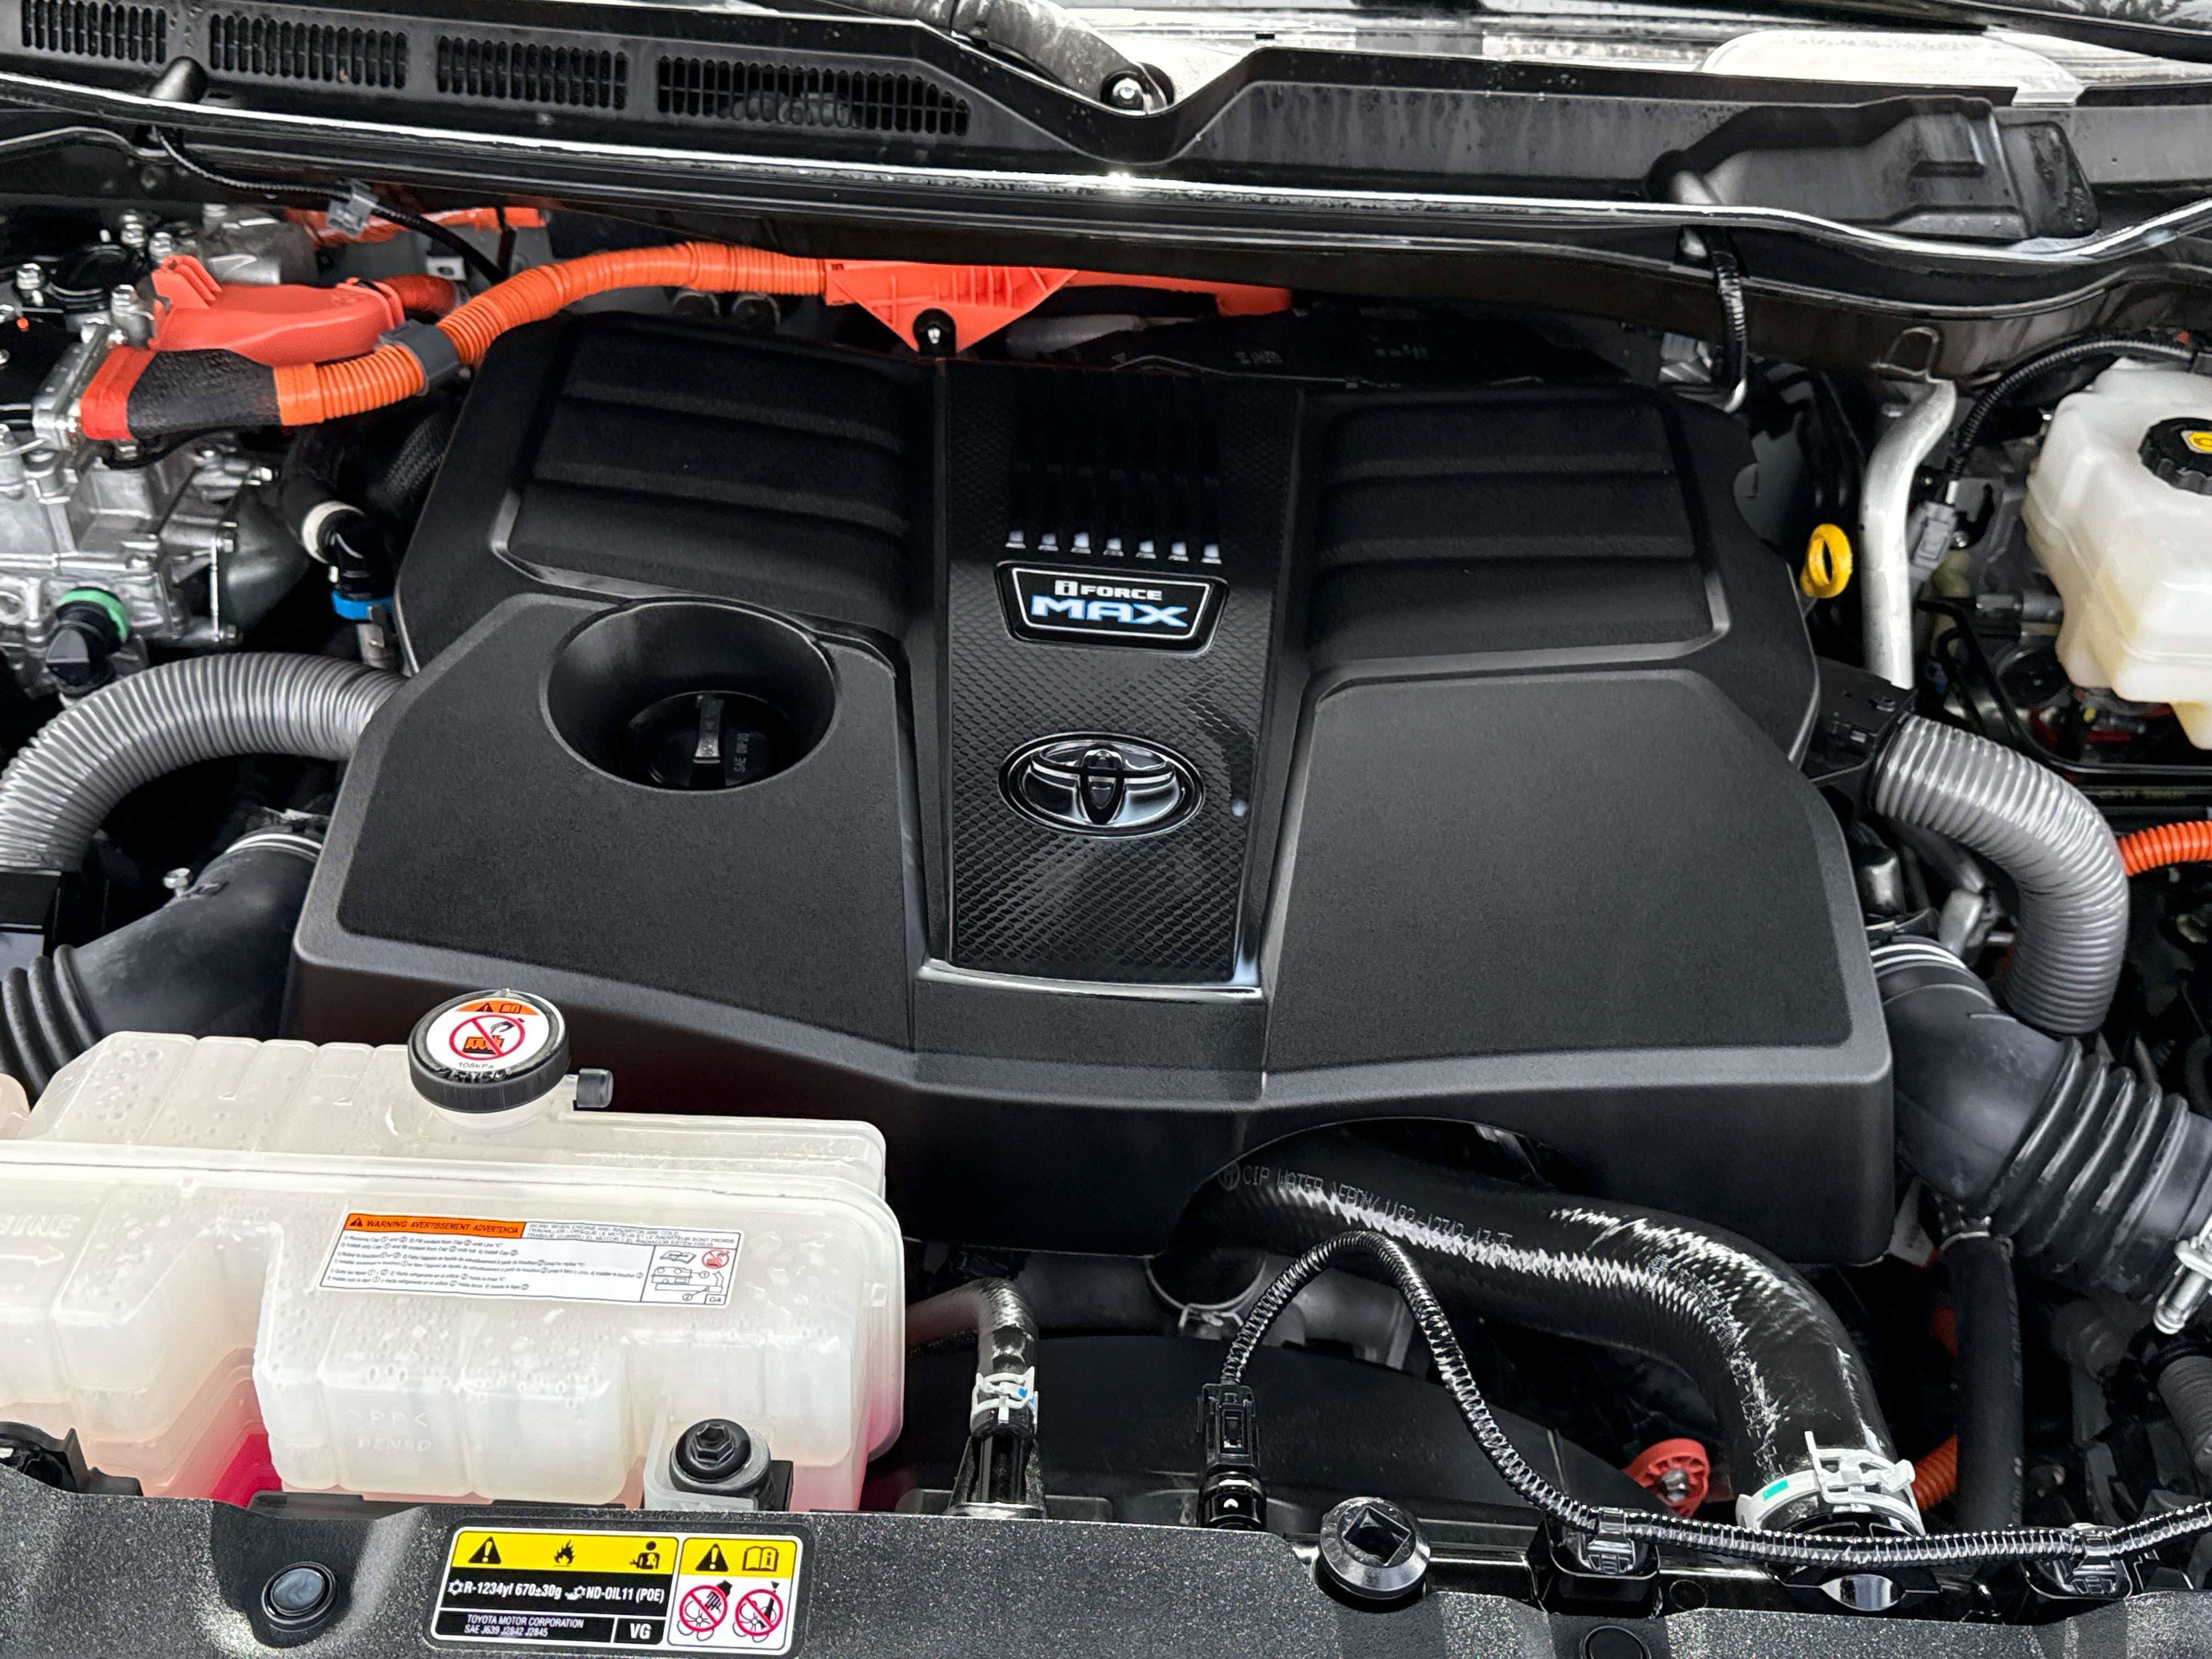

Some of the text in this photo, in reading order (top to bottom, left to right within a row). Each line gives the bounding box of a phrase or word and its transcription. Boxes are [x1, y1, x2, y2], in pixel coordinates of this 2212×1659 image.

[1031, 594, 1189, 628] MAX
[367, 1220, 518, 1233] WARNING AVERTISSEMENT ADVERTENCIA
[464, 1581, 664, 1604] R-1234yf 670±30g ND-OIL11 (POE)
[467, 1614, 584, 1628] TOYOTA MOTOR CORPORATION
[464, 1624, 481, 1634] SAE
[481, 1625, 500, 1635] J639
[524, 1627, 549, 1637] J2845
[630, 1622, 652, 1639] VG
